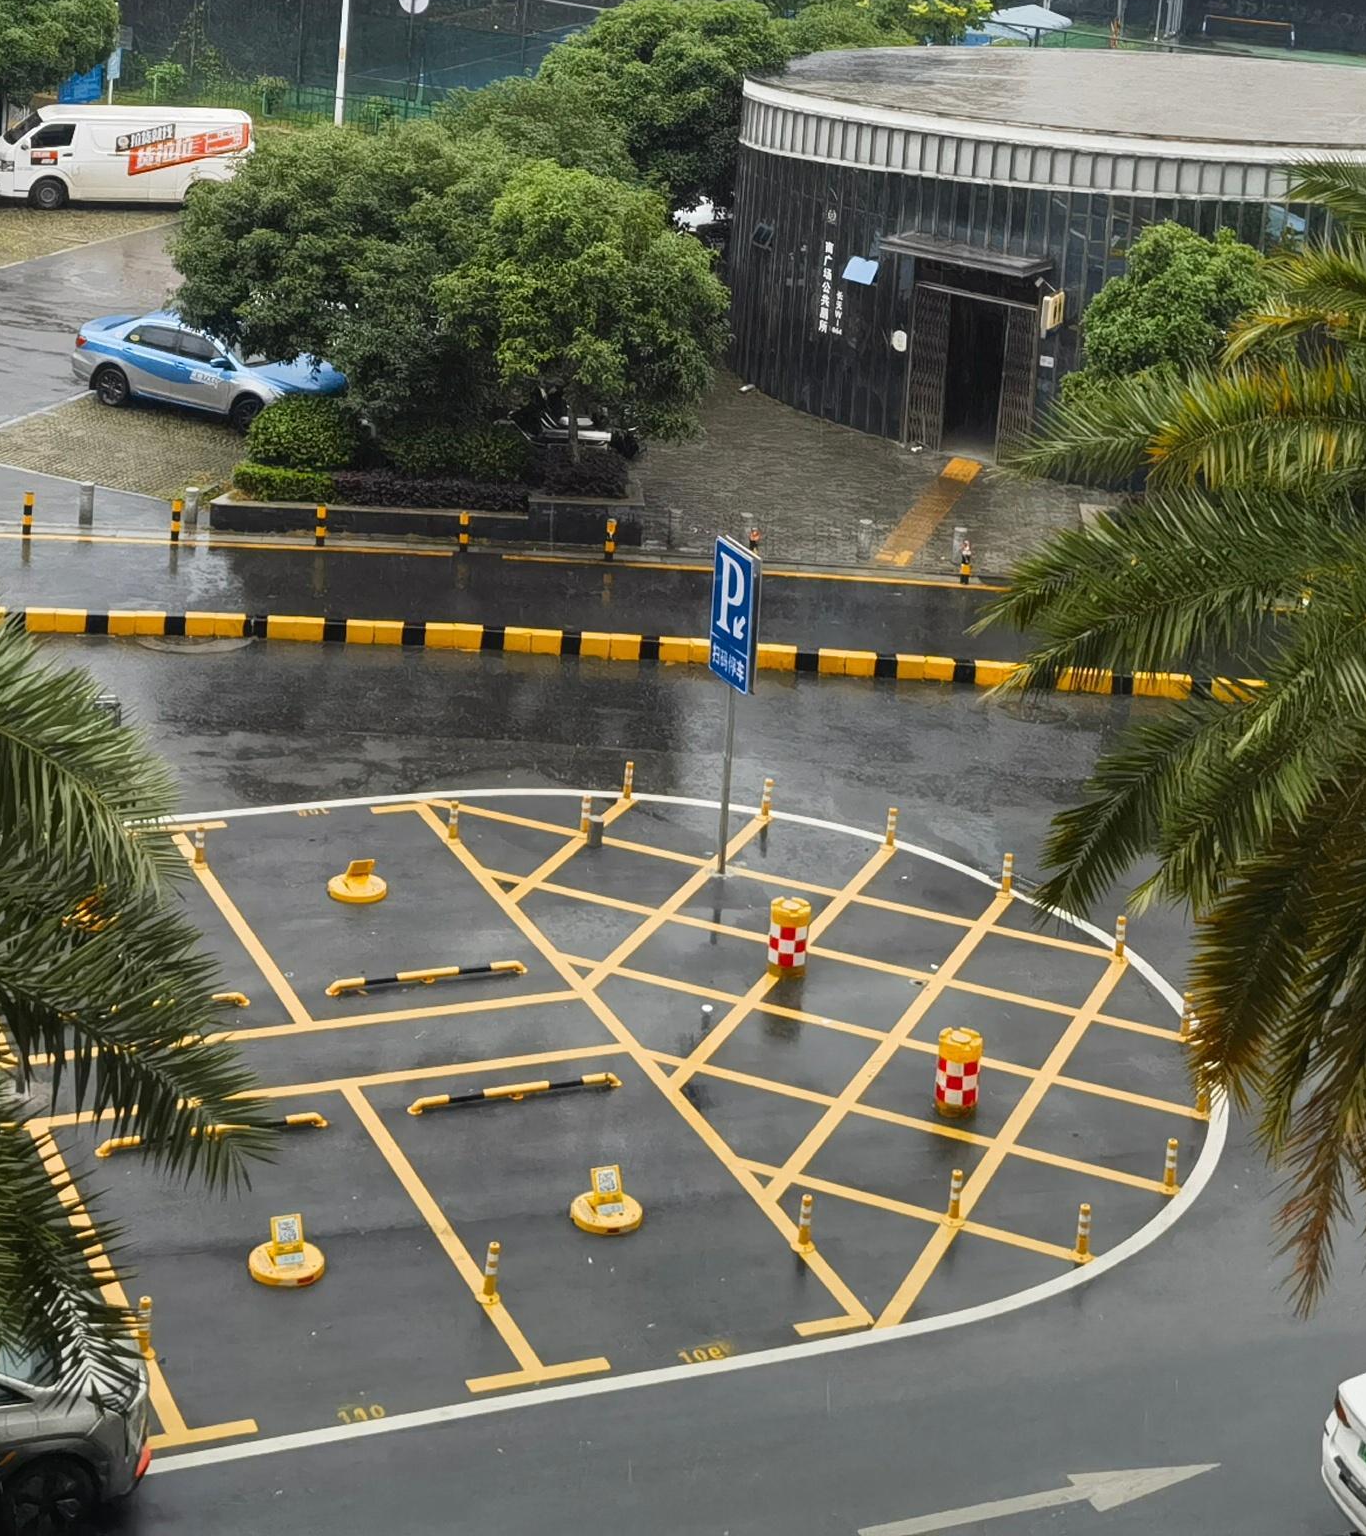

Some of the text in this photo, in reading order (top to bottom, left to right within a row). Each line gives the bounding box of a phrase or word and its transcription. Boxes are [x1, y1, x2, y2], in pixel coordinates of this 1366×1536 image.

[716, 551, 745, 634] P
[712, 642, 745, 683] 扫码停车
